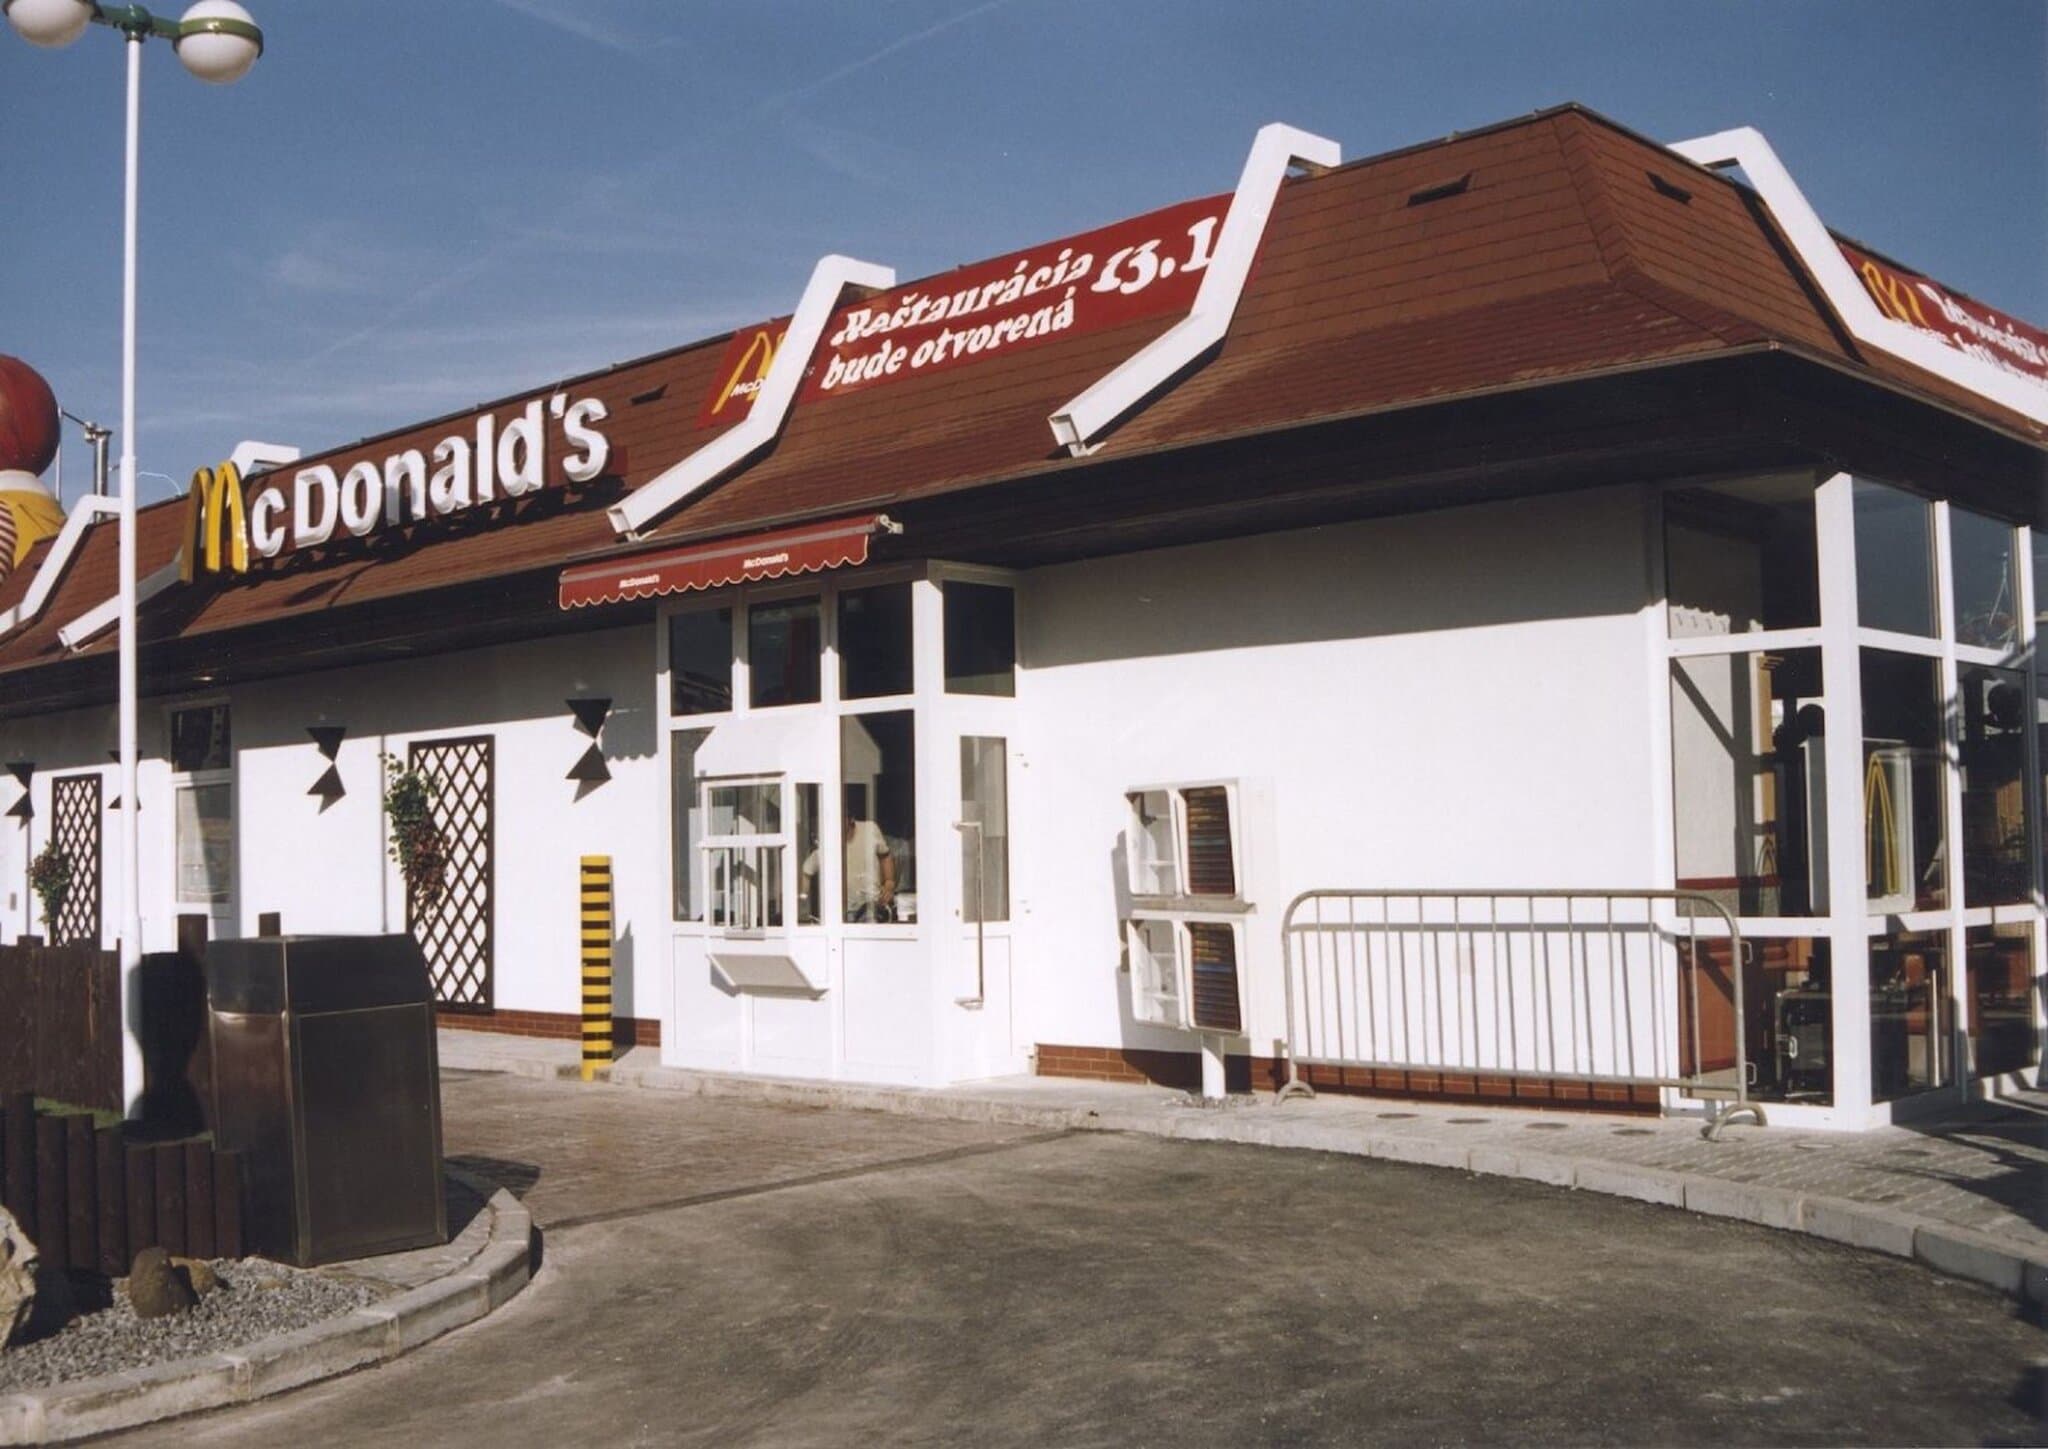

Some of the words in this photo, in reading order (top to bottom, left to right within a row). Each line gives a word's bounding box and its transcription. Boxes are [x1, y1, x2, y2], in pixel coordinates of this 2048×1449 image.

[820, 340, 911, 390] bude
[911, 287, 1075, 368] otvorená
[180, 393, 610, 583] McDonald's
[743, 553, 789, 569] McDonald's
